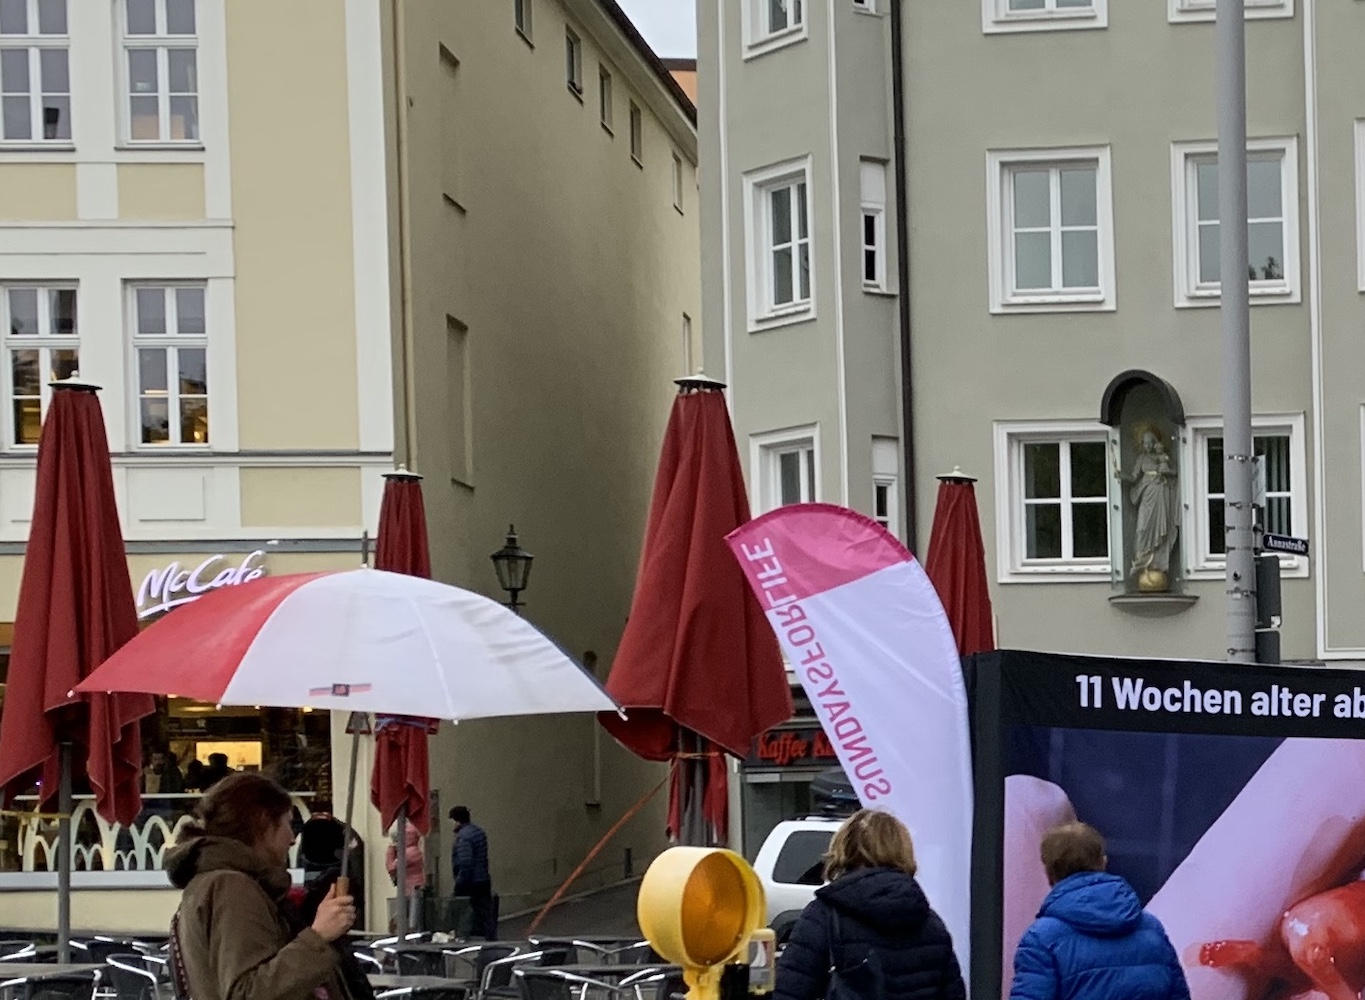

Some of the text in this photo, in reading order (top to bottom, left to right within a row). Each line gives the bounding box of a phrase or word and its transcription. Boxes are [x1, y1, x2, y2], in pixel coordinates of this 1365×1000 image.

[1267, 536, 1306, 552] Annastraße
[1075, 675, 1102, 708] 11
[1111, 677, 1242, 715] Wochen
[1250, 684, 1326, 717] alter
